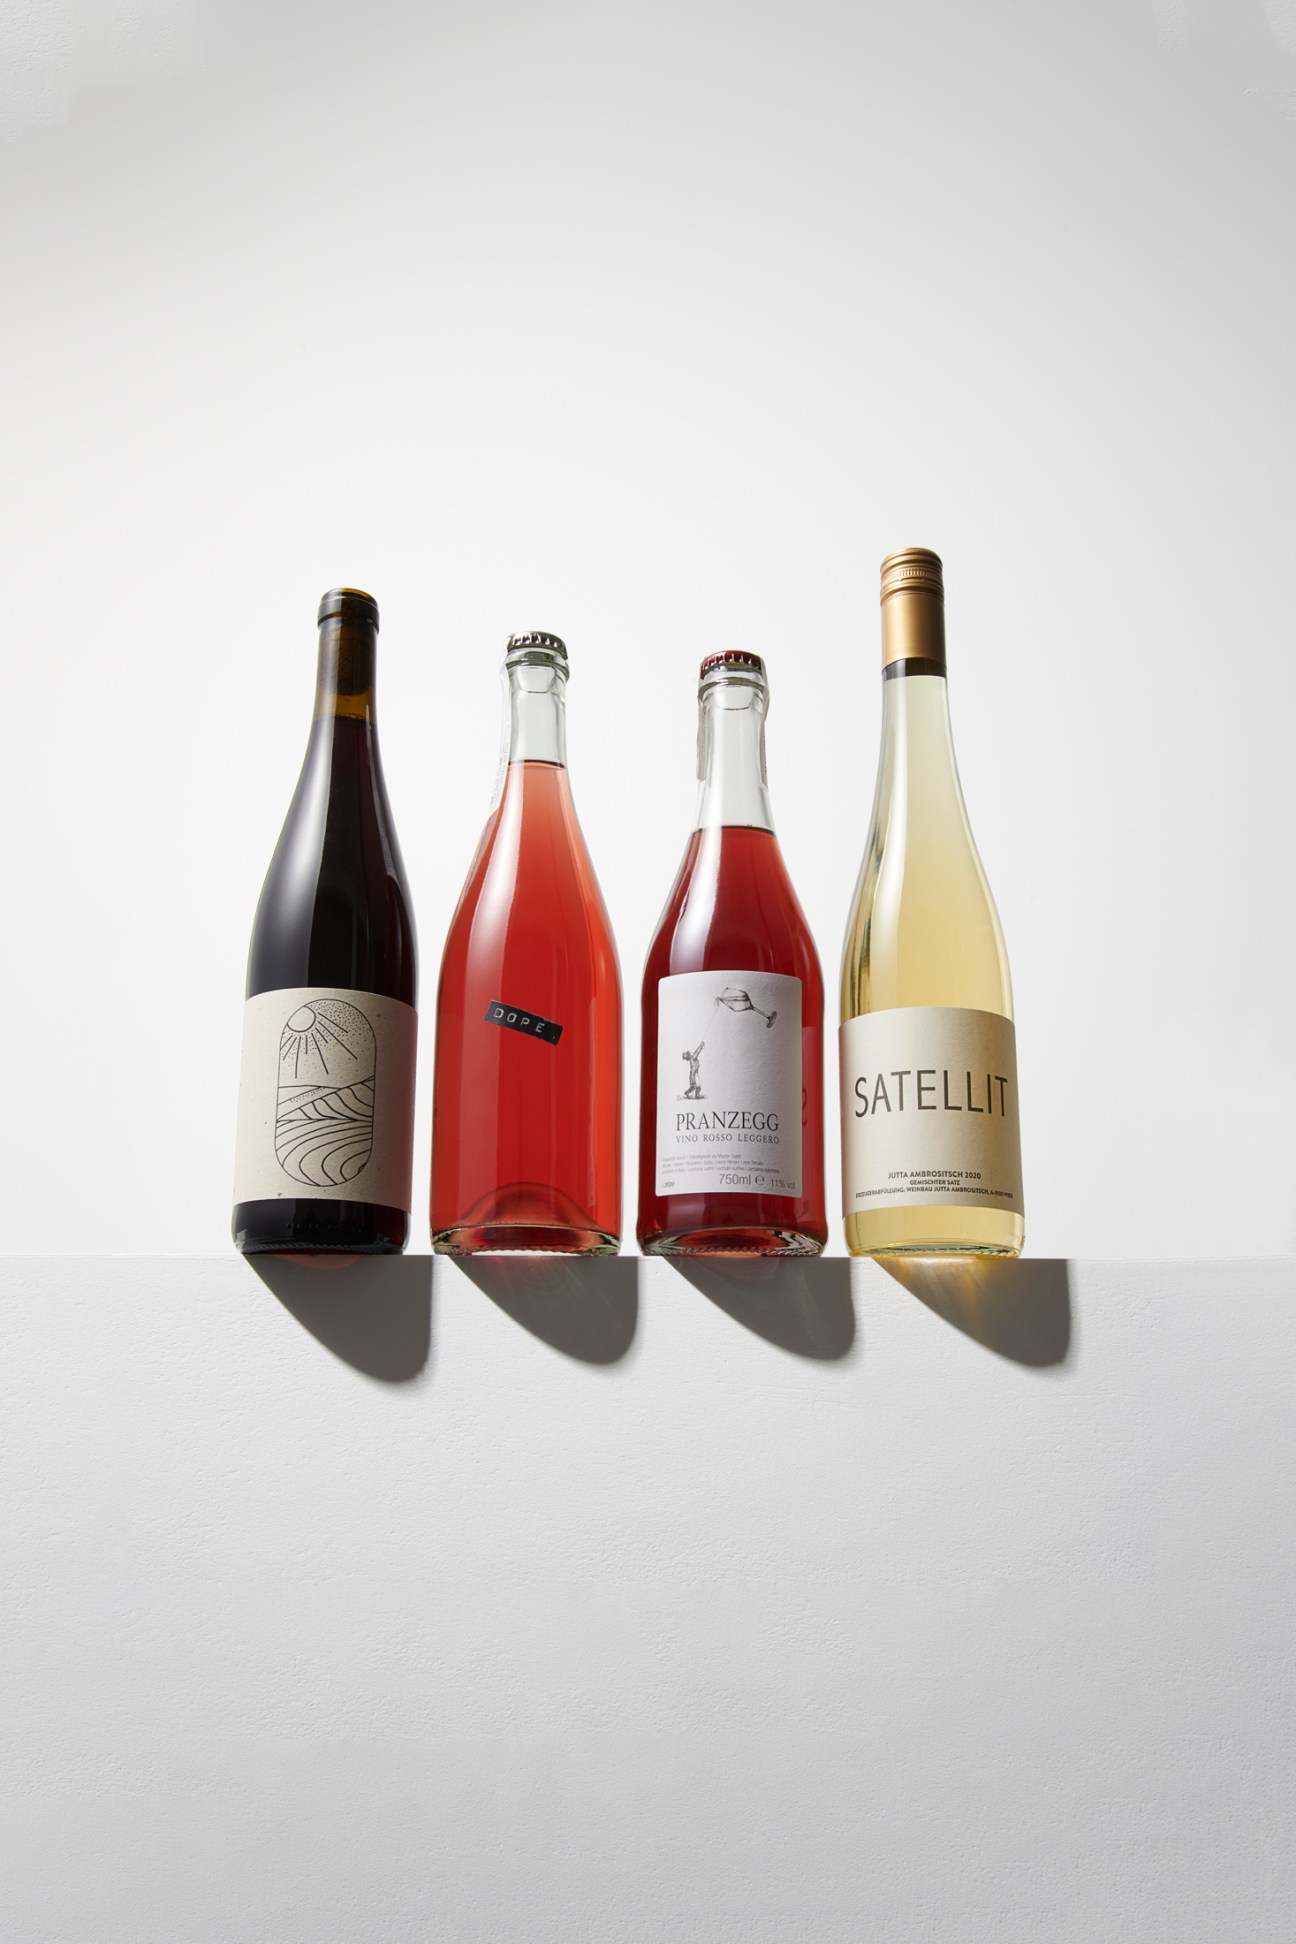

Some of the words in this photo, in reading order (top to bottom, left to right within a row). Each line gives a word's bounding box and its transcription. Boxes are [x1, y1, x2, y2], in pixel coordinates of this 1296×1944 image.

[854, 1069, 1009, 1118] SATELLIT
[675, 1111, 780, 1132] PRANZEGG
[675, 1134, 699, 1144] VINO
[703, 1133, 733, 1142] ROSSO
[737, 1133, 780, 1145] LEGGERO
[718, 1173, 752, 1186] 750ml
[887, 1171, 909, 1180] JUTTA
[909, 1170, 964, 1178] AMBROSITSCH
[964, 1171, 982, 1180] 2020
[906, 1185, 933, 1193] WEINBAU
